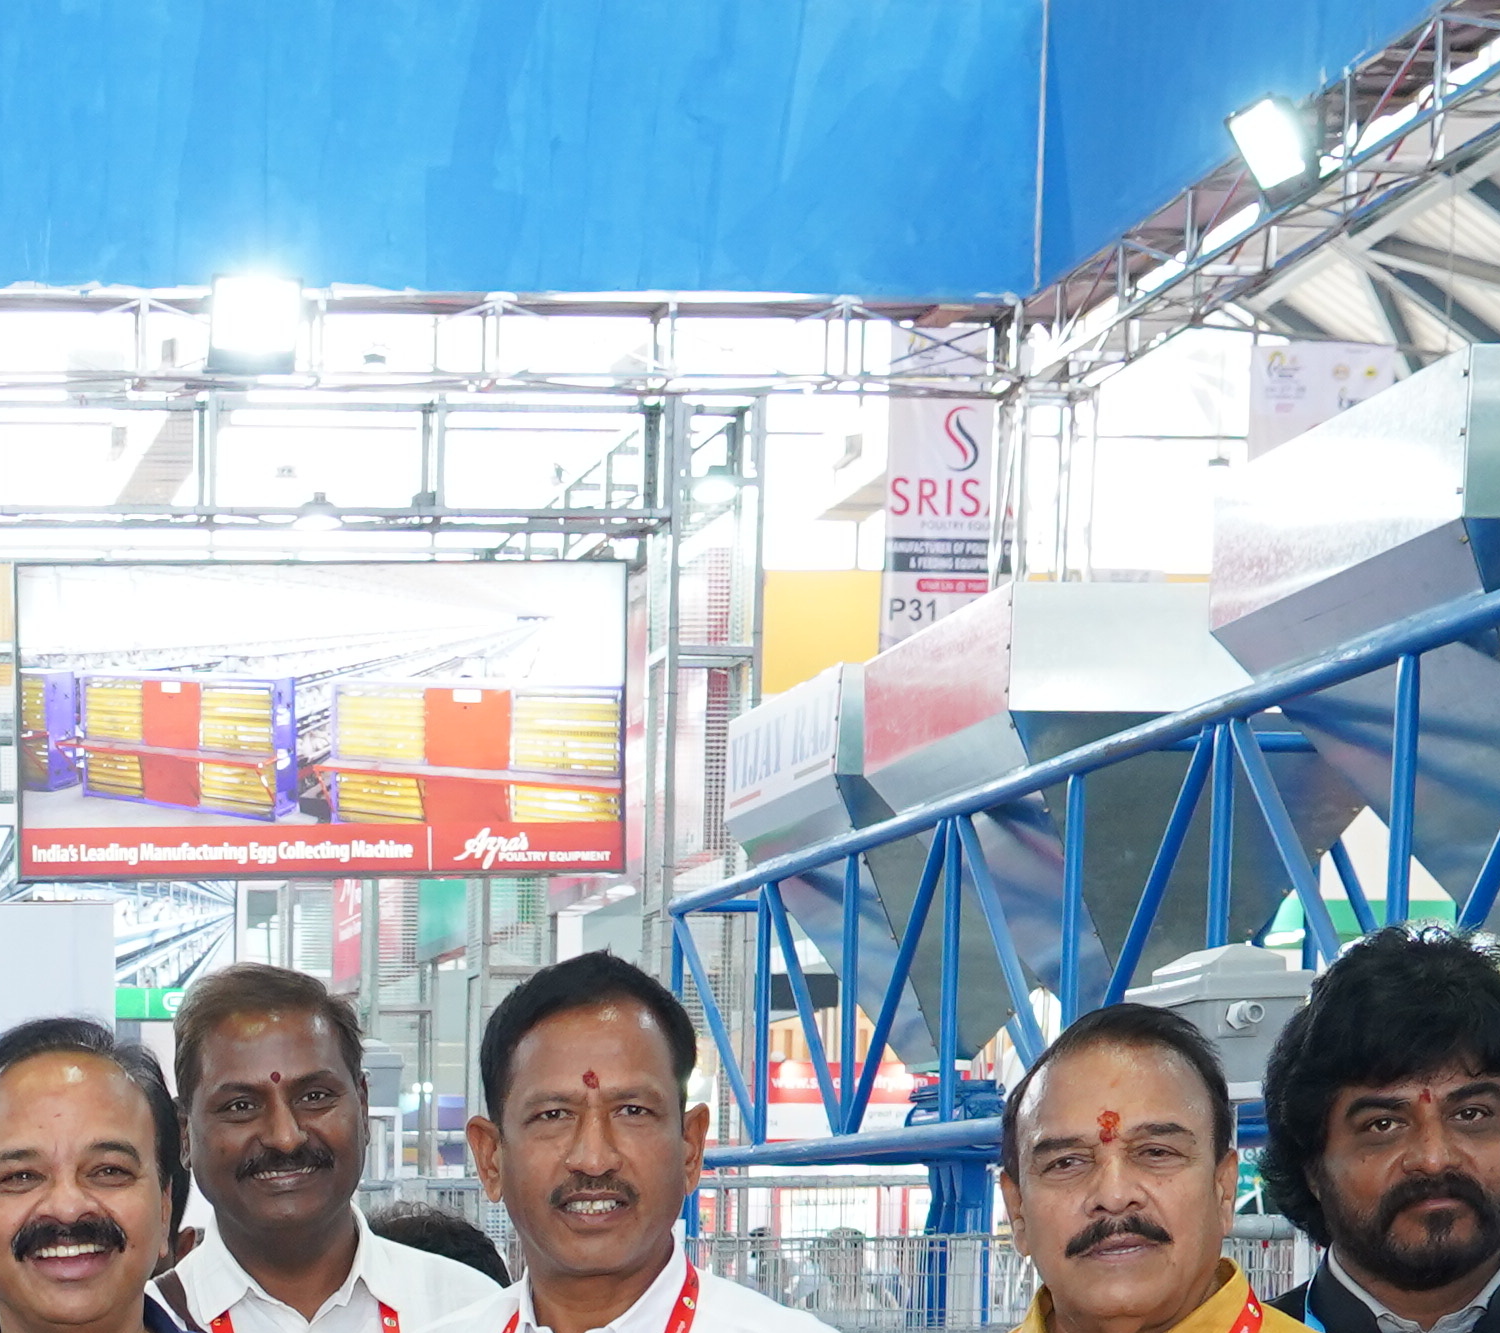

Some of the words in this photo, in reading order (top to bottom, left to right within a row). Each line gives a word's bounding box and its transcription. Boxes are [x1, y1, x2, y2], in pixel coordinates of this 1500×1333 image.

[732, 713, 788, 793] VIJAY
[32, 843, 79, 863] India's
[80, 842, 139, 866] Leading
[140, 842, 248, 865] Manufacturing
[249, 842, 278, 865] Egg
[278, 840, 351, 863] Collecting
[351, 839, 414, 860] Machine
[453, 827, 529, 870] Azra's
[498, 851, 549, 862] POULTRY
[549, 850, 611, 862] EQUIPMENT
